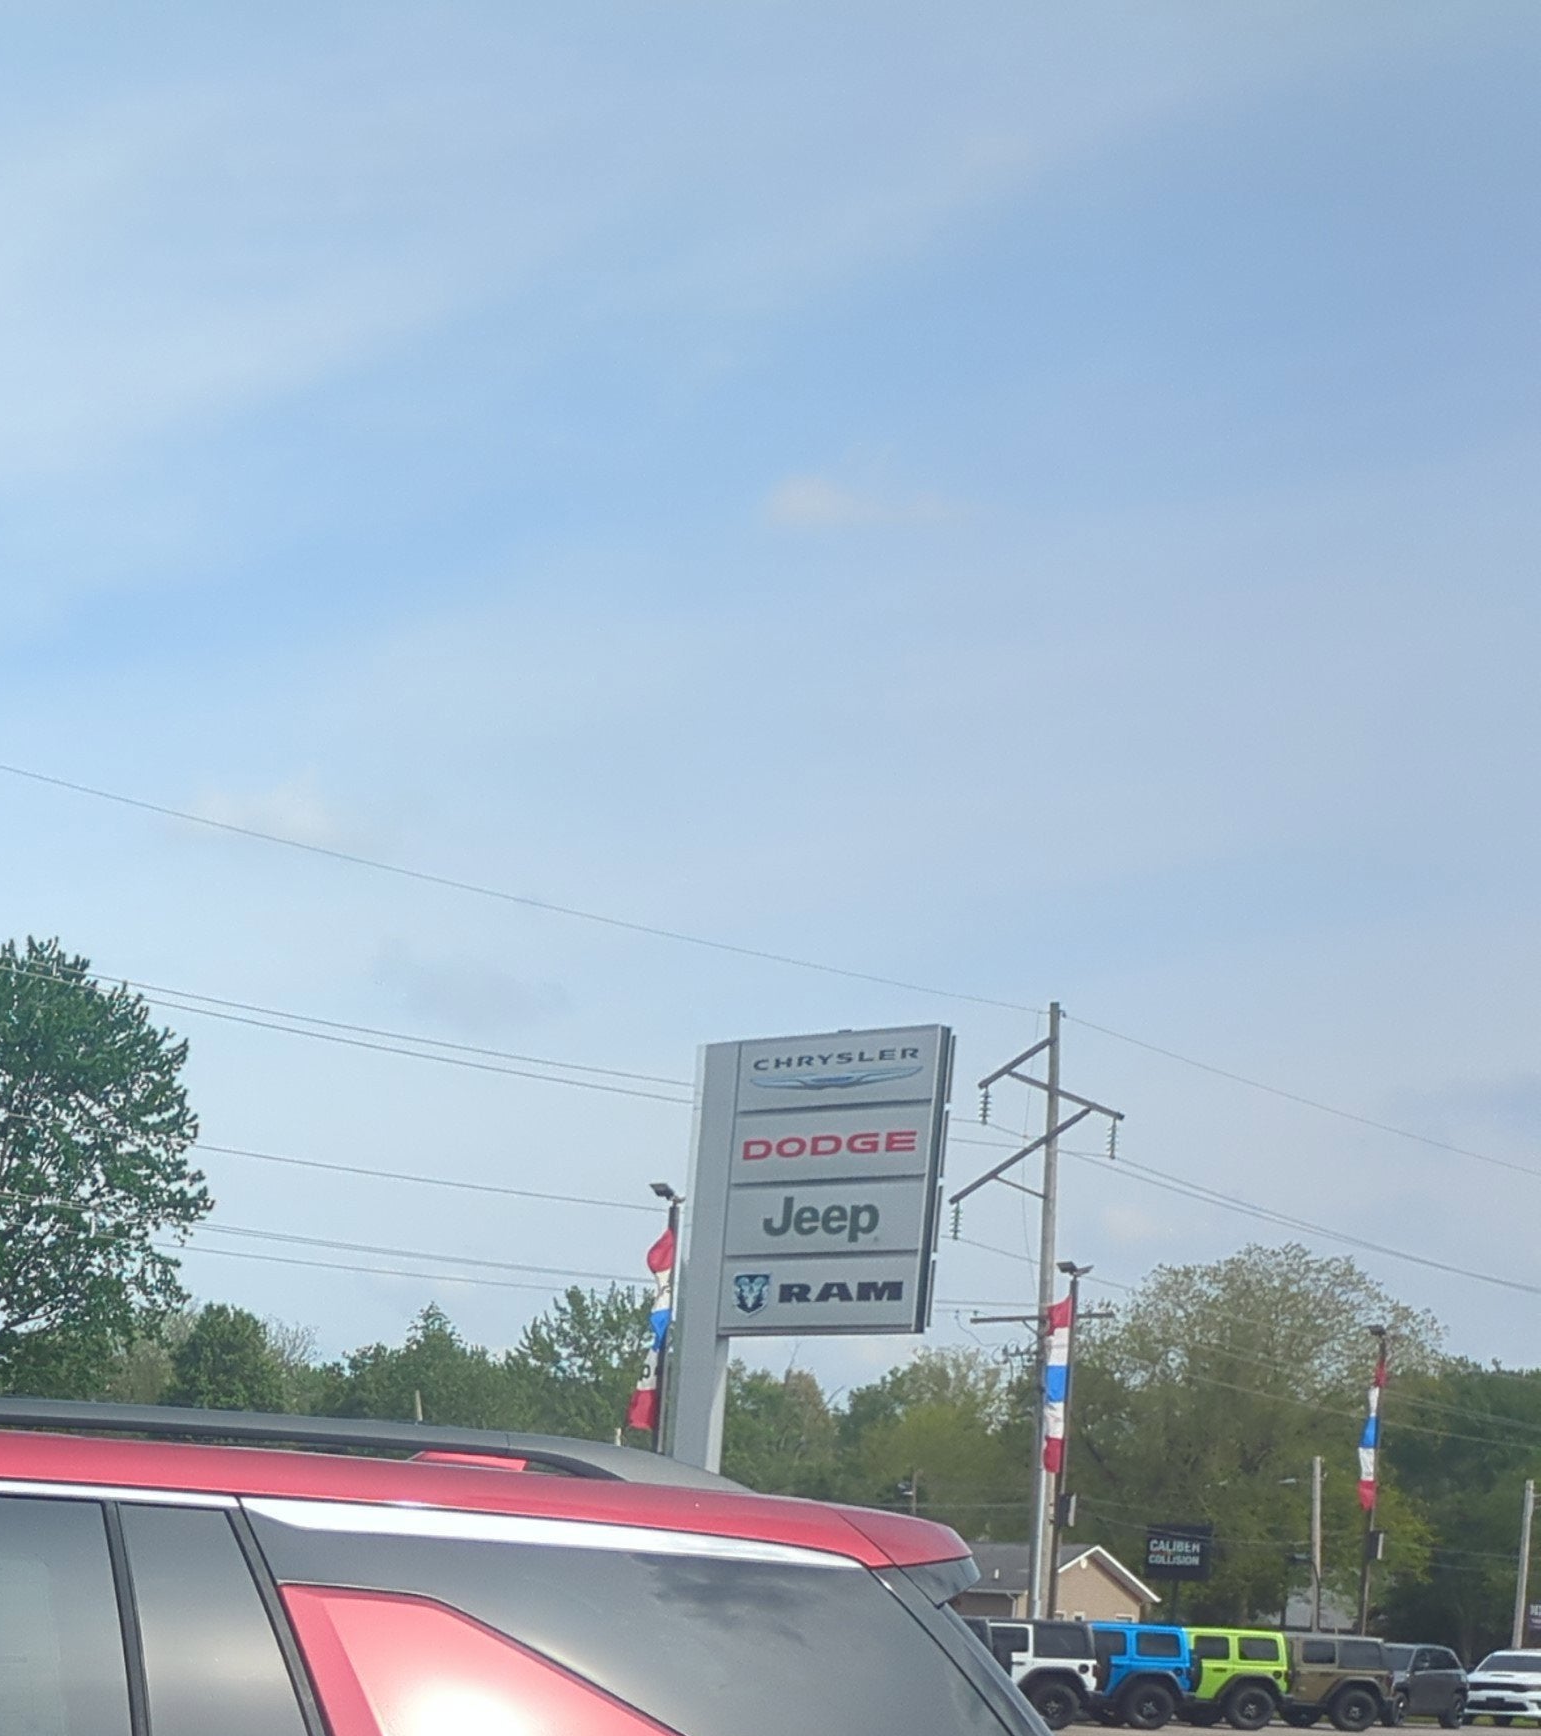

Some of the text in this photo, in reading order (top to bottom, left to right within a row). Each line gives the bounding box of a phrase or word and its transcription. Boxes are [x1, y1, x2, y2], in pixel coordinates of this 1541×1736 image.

[752, 1046, 920, 1072] CHRYSLER
[742, 1130, 918, 1161] DODGE
[762, 1195, 880, 1243] Jeep
[778, 1280, 904, 1304] RAM
[1149, 1538, 1201, 1554] CALIBER
[1148, 1553, 1200, 1567] COLLISION
